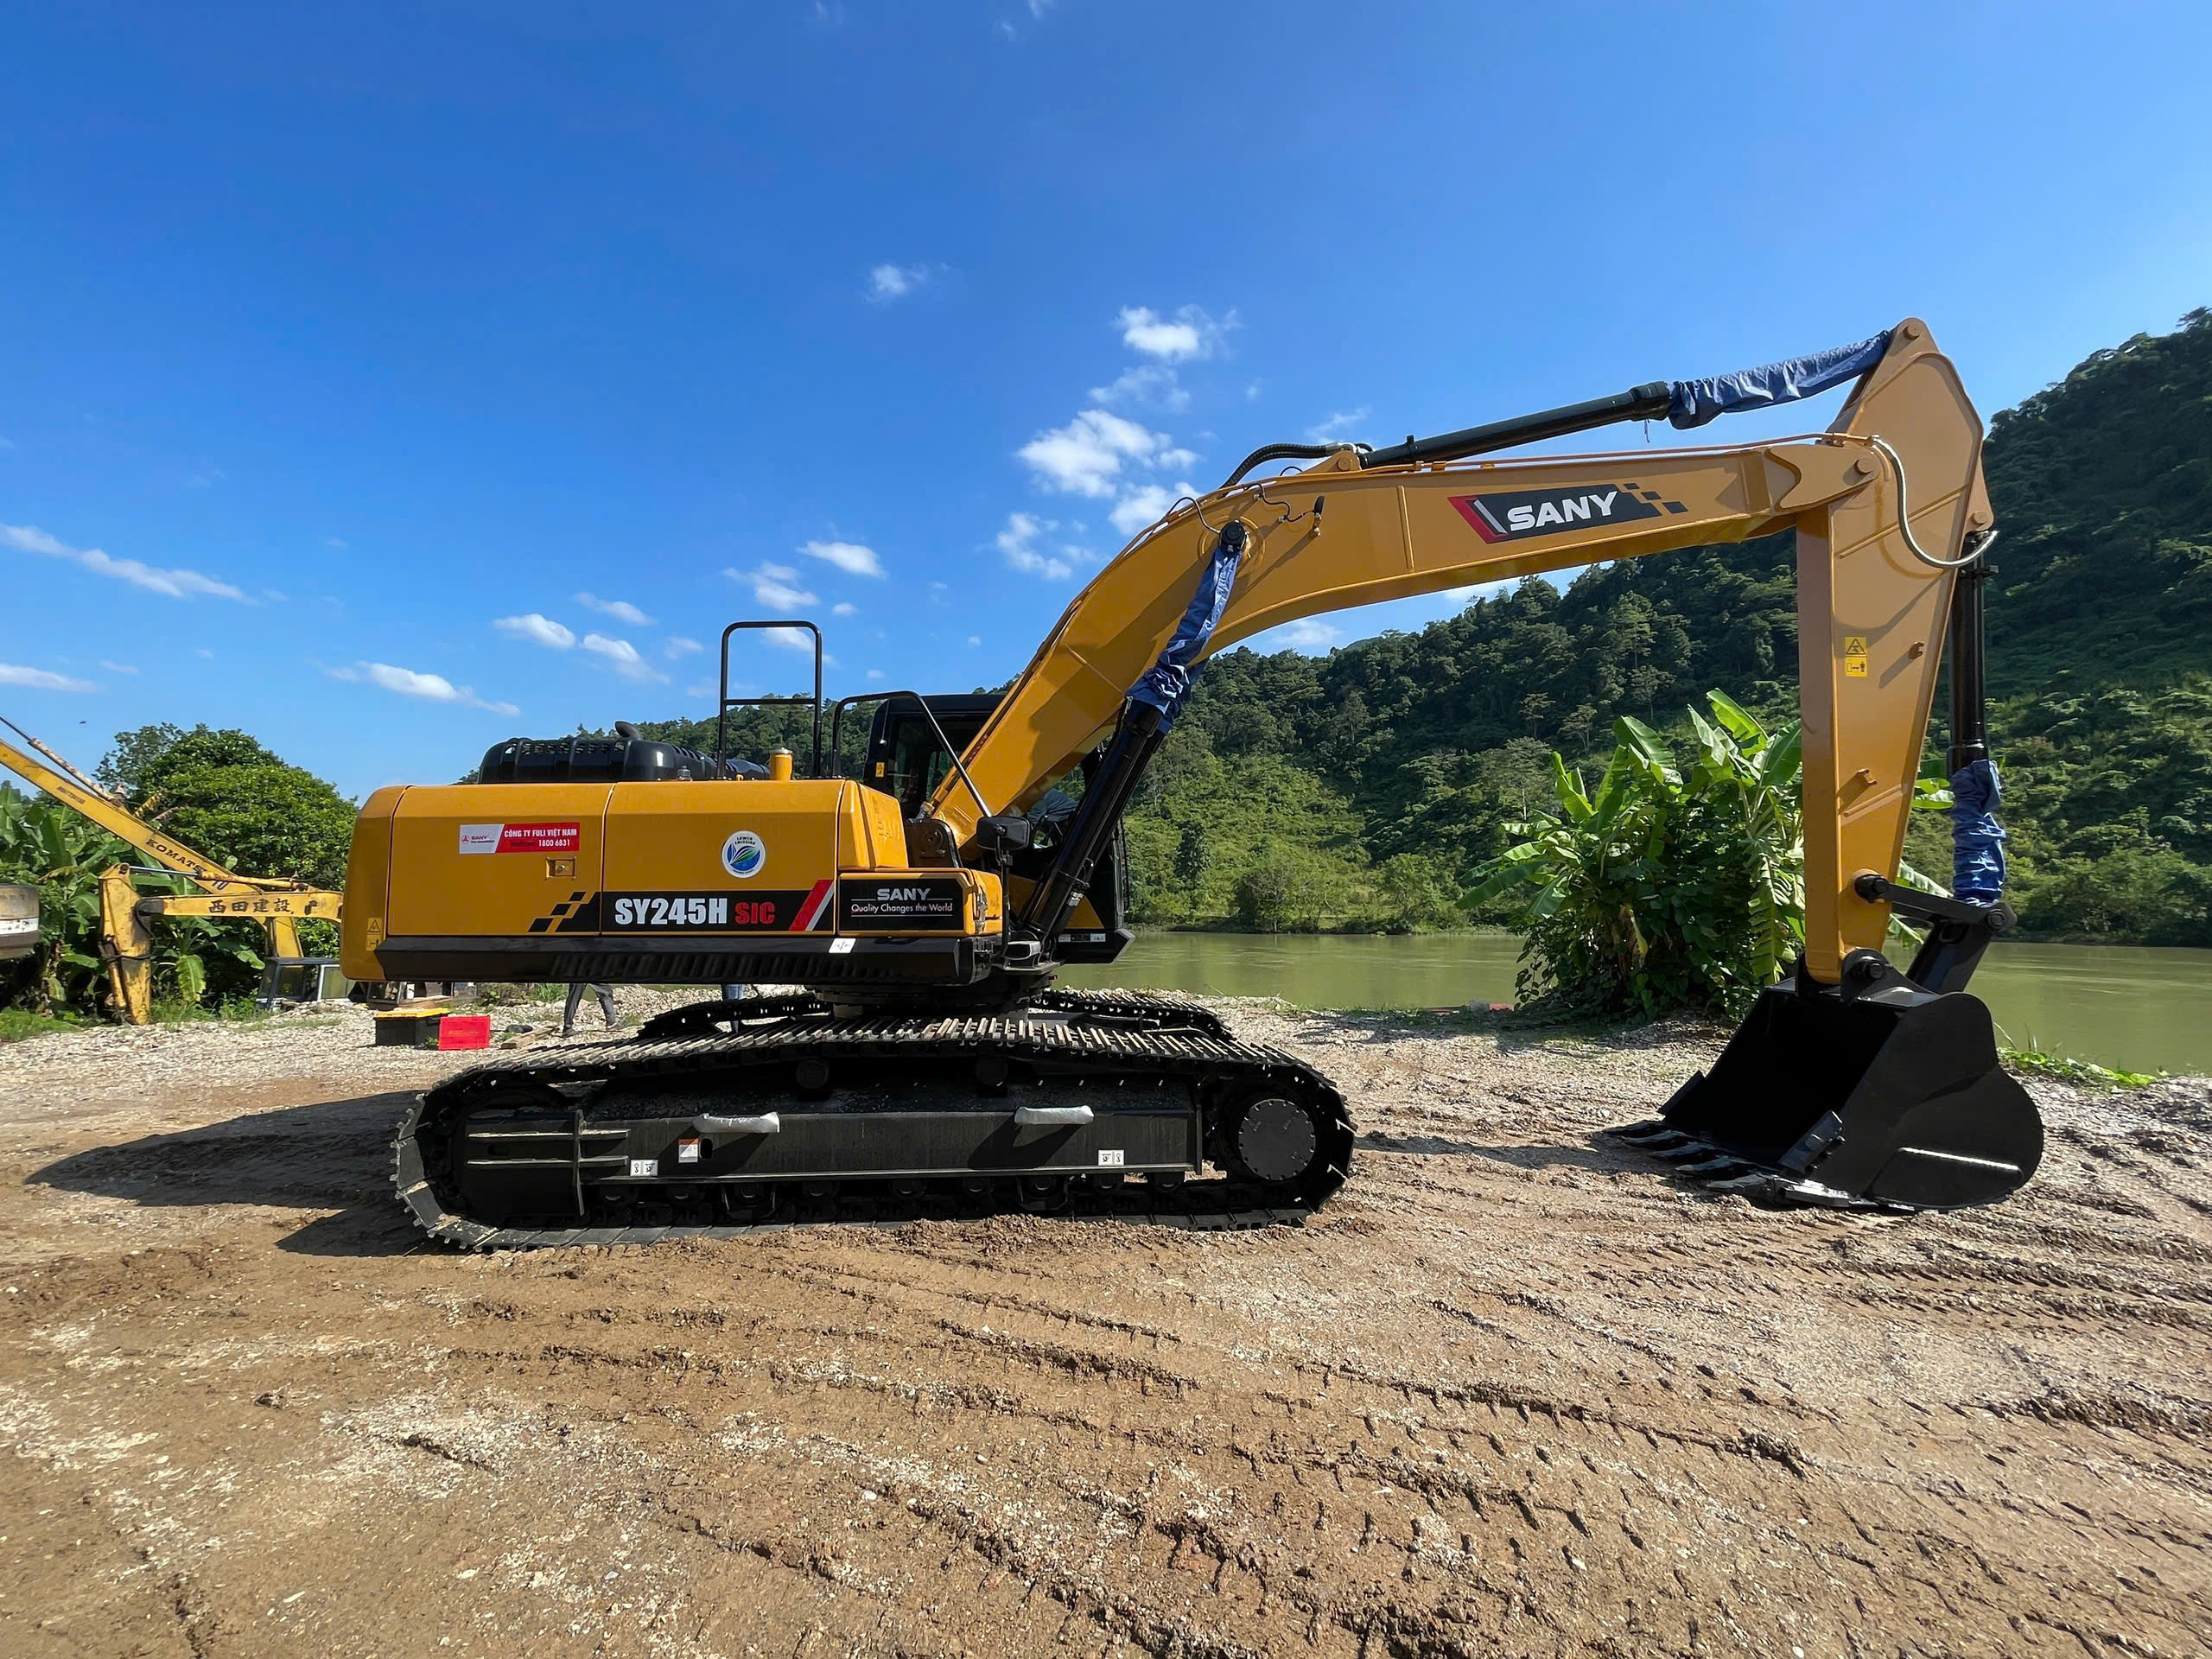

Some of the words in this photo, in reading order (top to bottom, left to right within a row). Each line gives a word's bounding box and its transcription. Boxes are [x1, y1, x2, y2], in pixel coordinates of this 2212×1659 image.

[1507, 491, 1618, 531] SANY
[505, 828, 522, 837] CÔNG
[547, 829, 561, 838] VIỆT
[145, 838, 207, 873] KOMATS
[877, 888, 931, 900] SANY
[614, 898, 728, 925] SY245H
[734, 901, 775, 925] SIC
[851, 903, 879, 913] Quality
[880, 903, 913, 913] Changes
[915, 903, 926, 912] the
[928, 903, 953, 912] World
